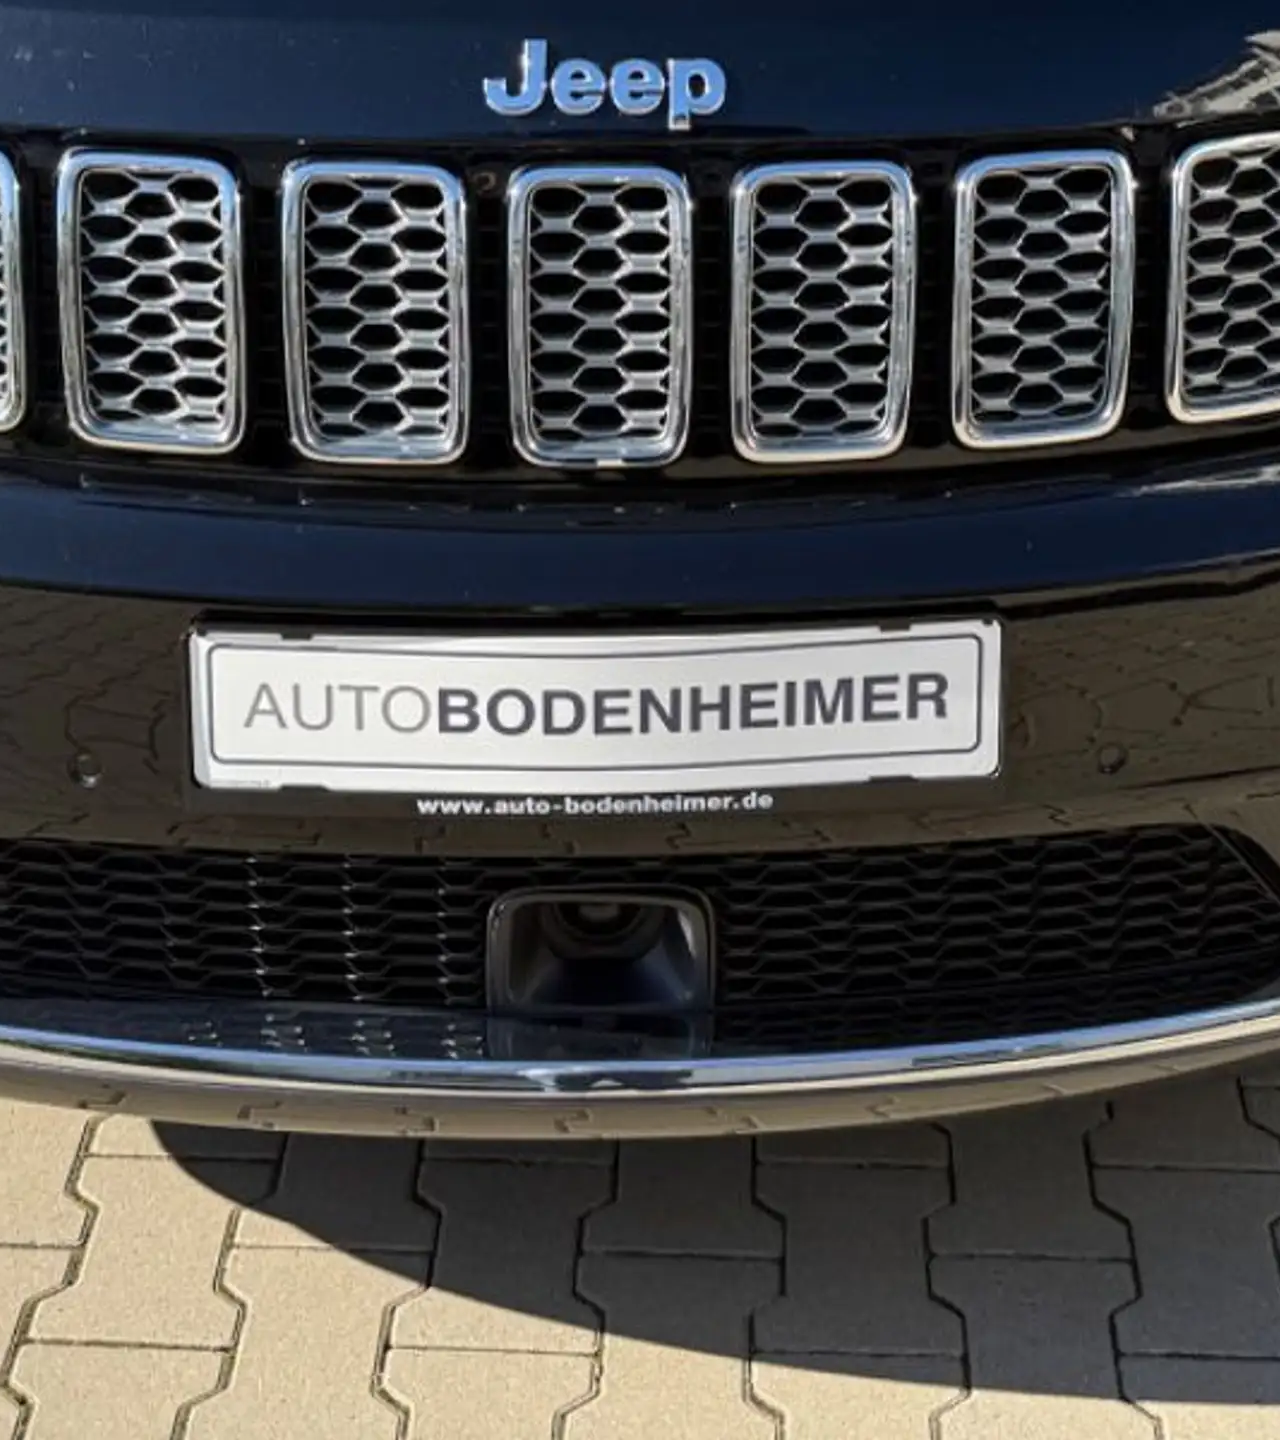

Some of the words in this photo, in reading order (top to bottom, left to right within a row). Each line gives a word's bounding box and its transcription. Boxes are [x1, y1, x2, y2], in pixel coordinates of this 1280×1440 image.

[483, 38, 726, 130] Jeep
[243, 672, 949, 737] AUTOBODENHEIMER
[416, 792, 774, 815] www.auto-bodenheimer.de
